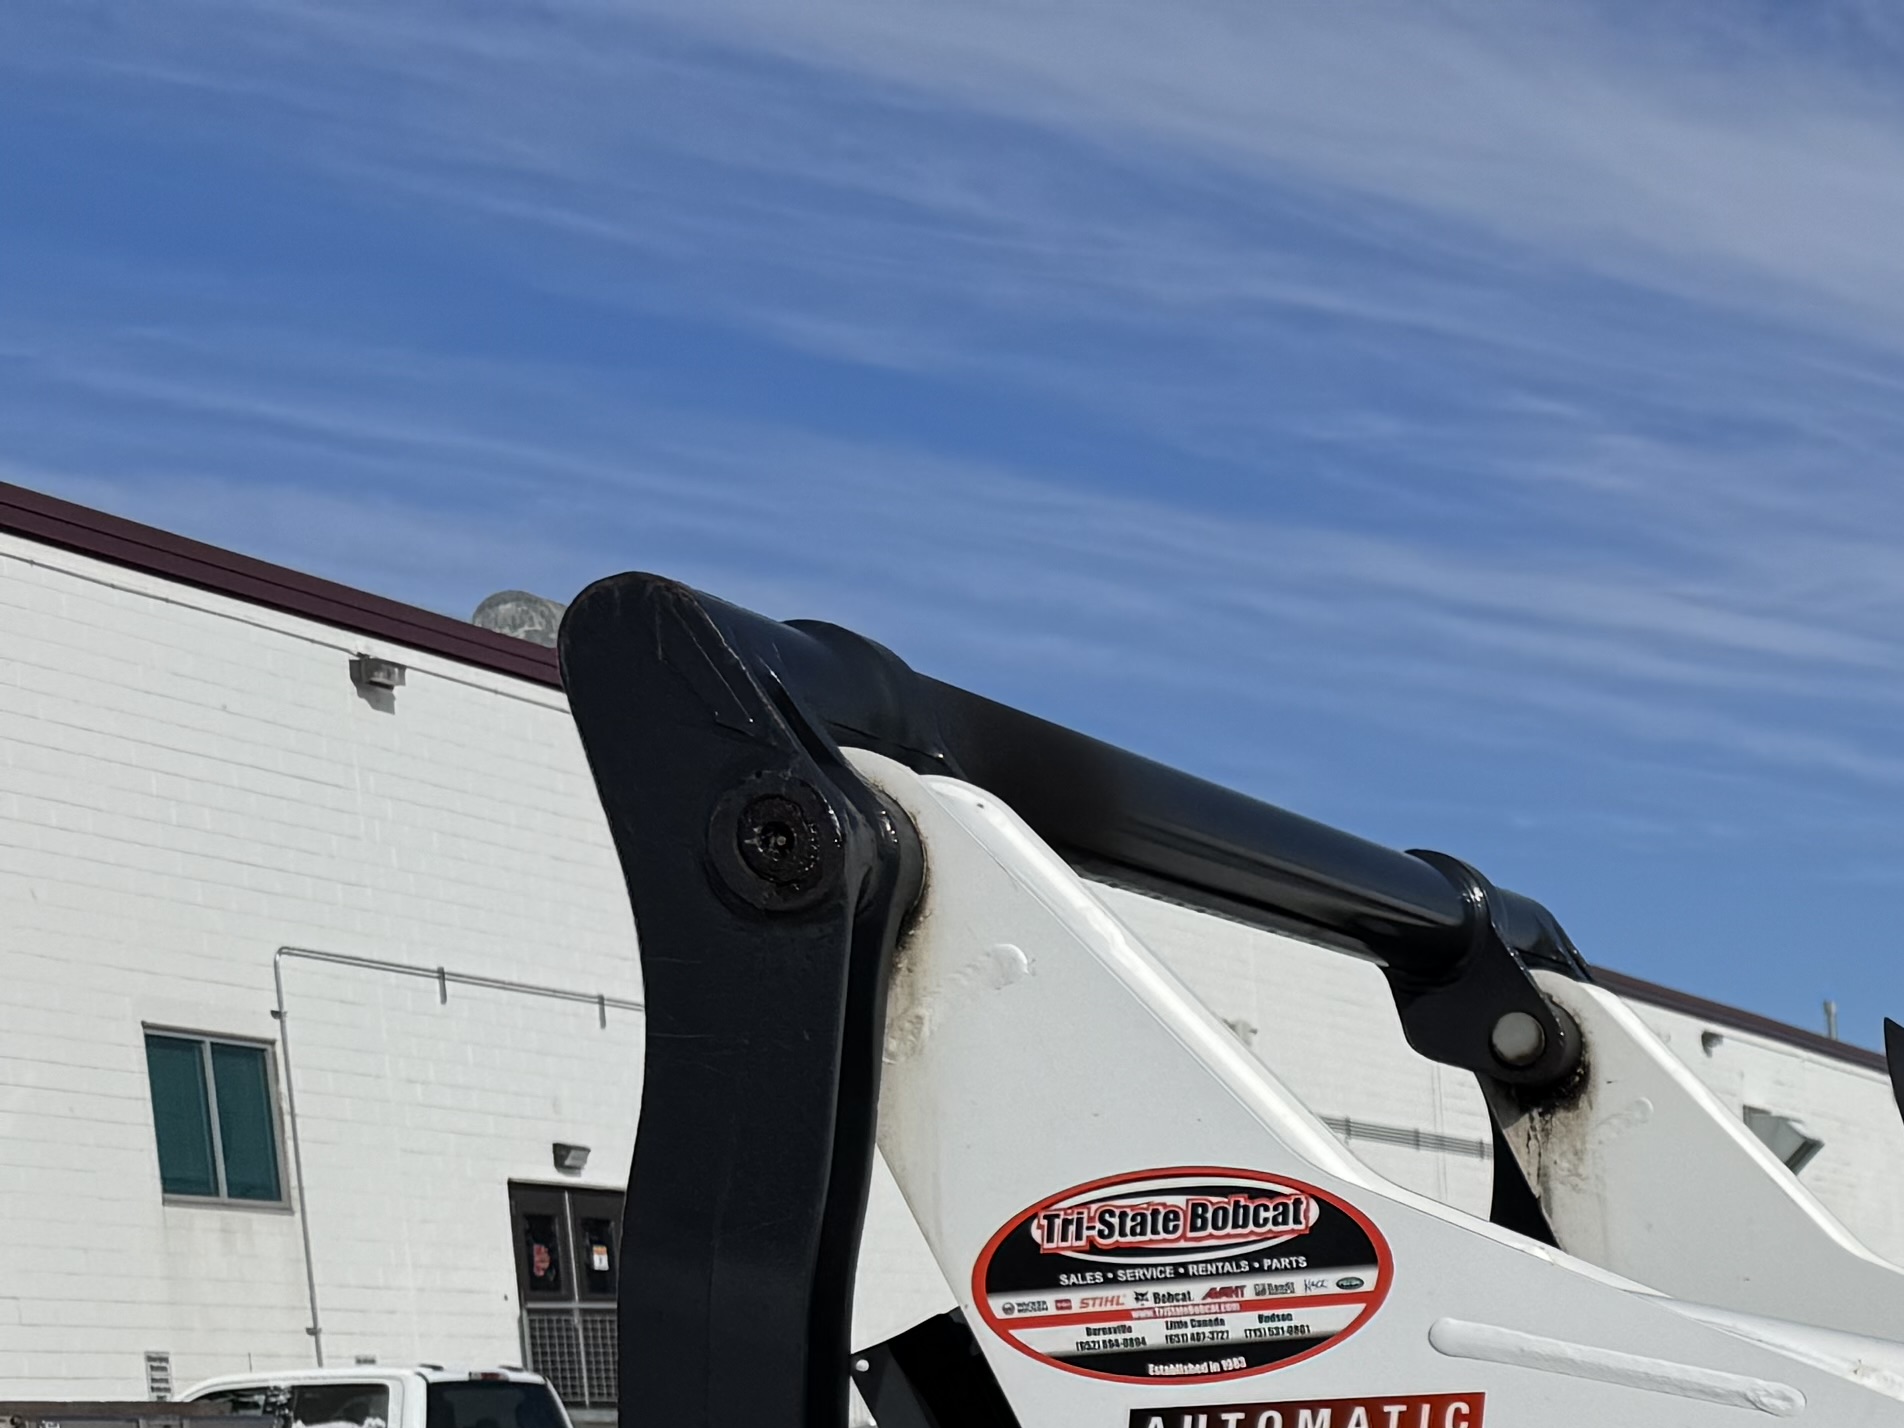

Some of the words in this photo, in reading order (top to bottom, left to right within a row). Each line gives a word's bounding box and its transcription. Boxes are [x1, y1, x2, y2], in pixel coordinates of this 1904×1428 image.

[1041, 1204, 1181, 1247] Tri-State
[1188, 1194, 1306, 1235] Bobcat
[1059, 1271, 1104, 1286] SALES
[1117, 1266, 1174, 1282] SERVICE
[1188, 1260, 1250, 1277] RENTALS
[1263, 1256, 1308, 1271] PARTS
[1079, 1294, 1126, 1309] STIHL
[1152, 1290, 1192, 1305] Bobcat
